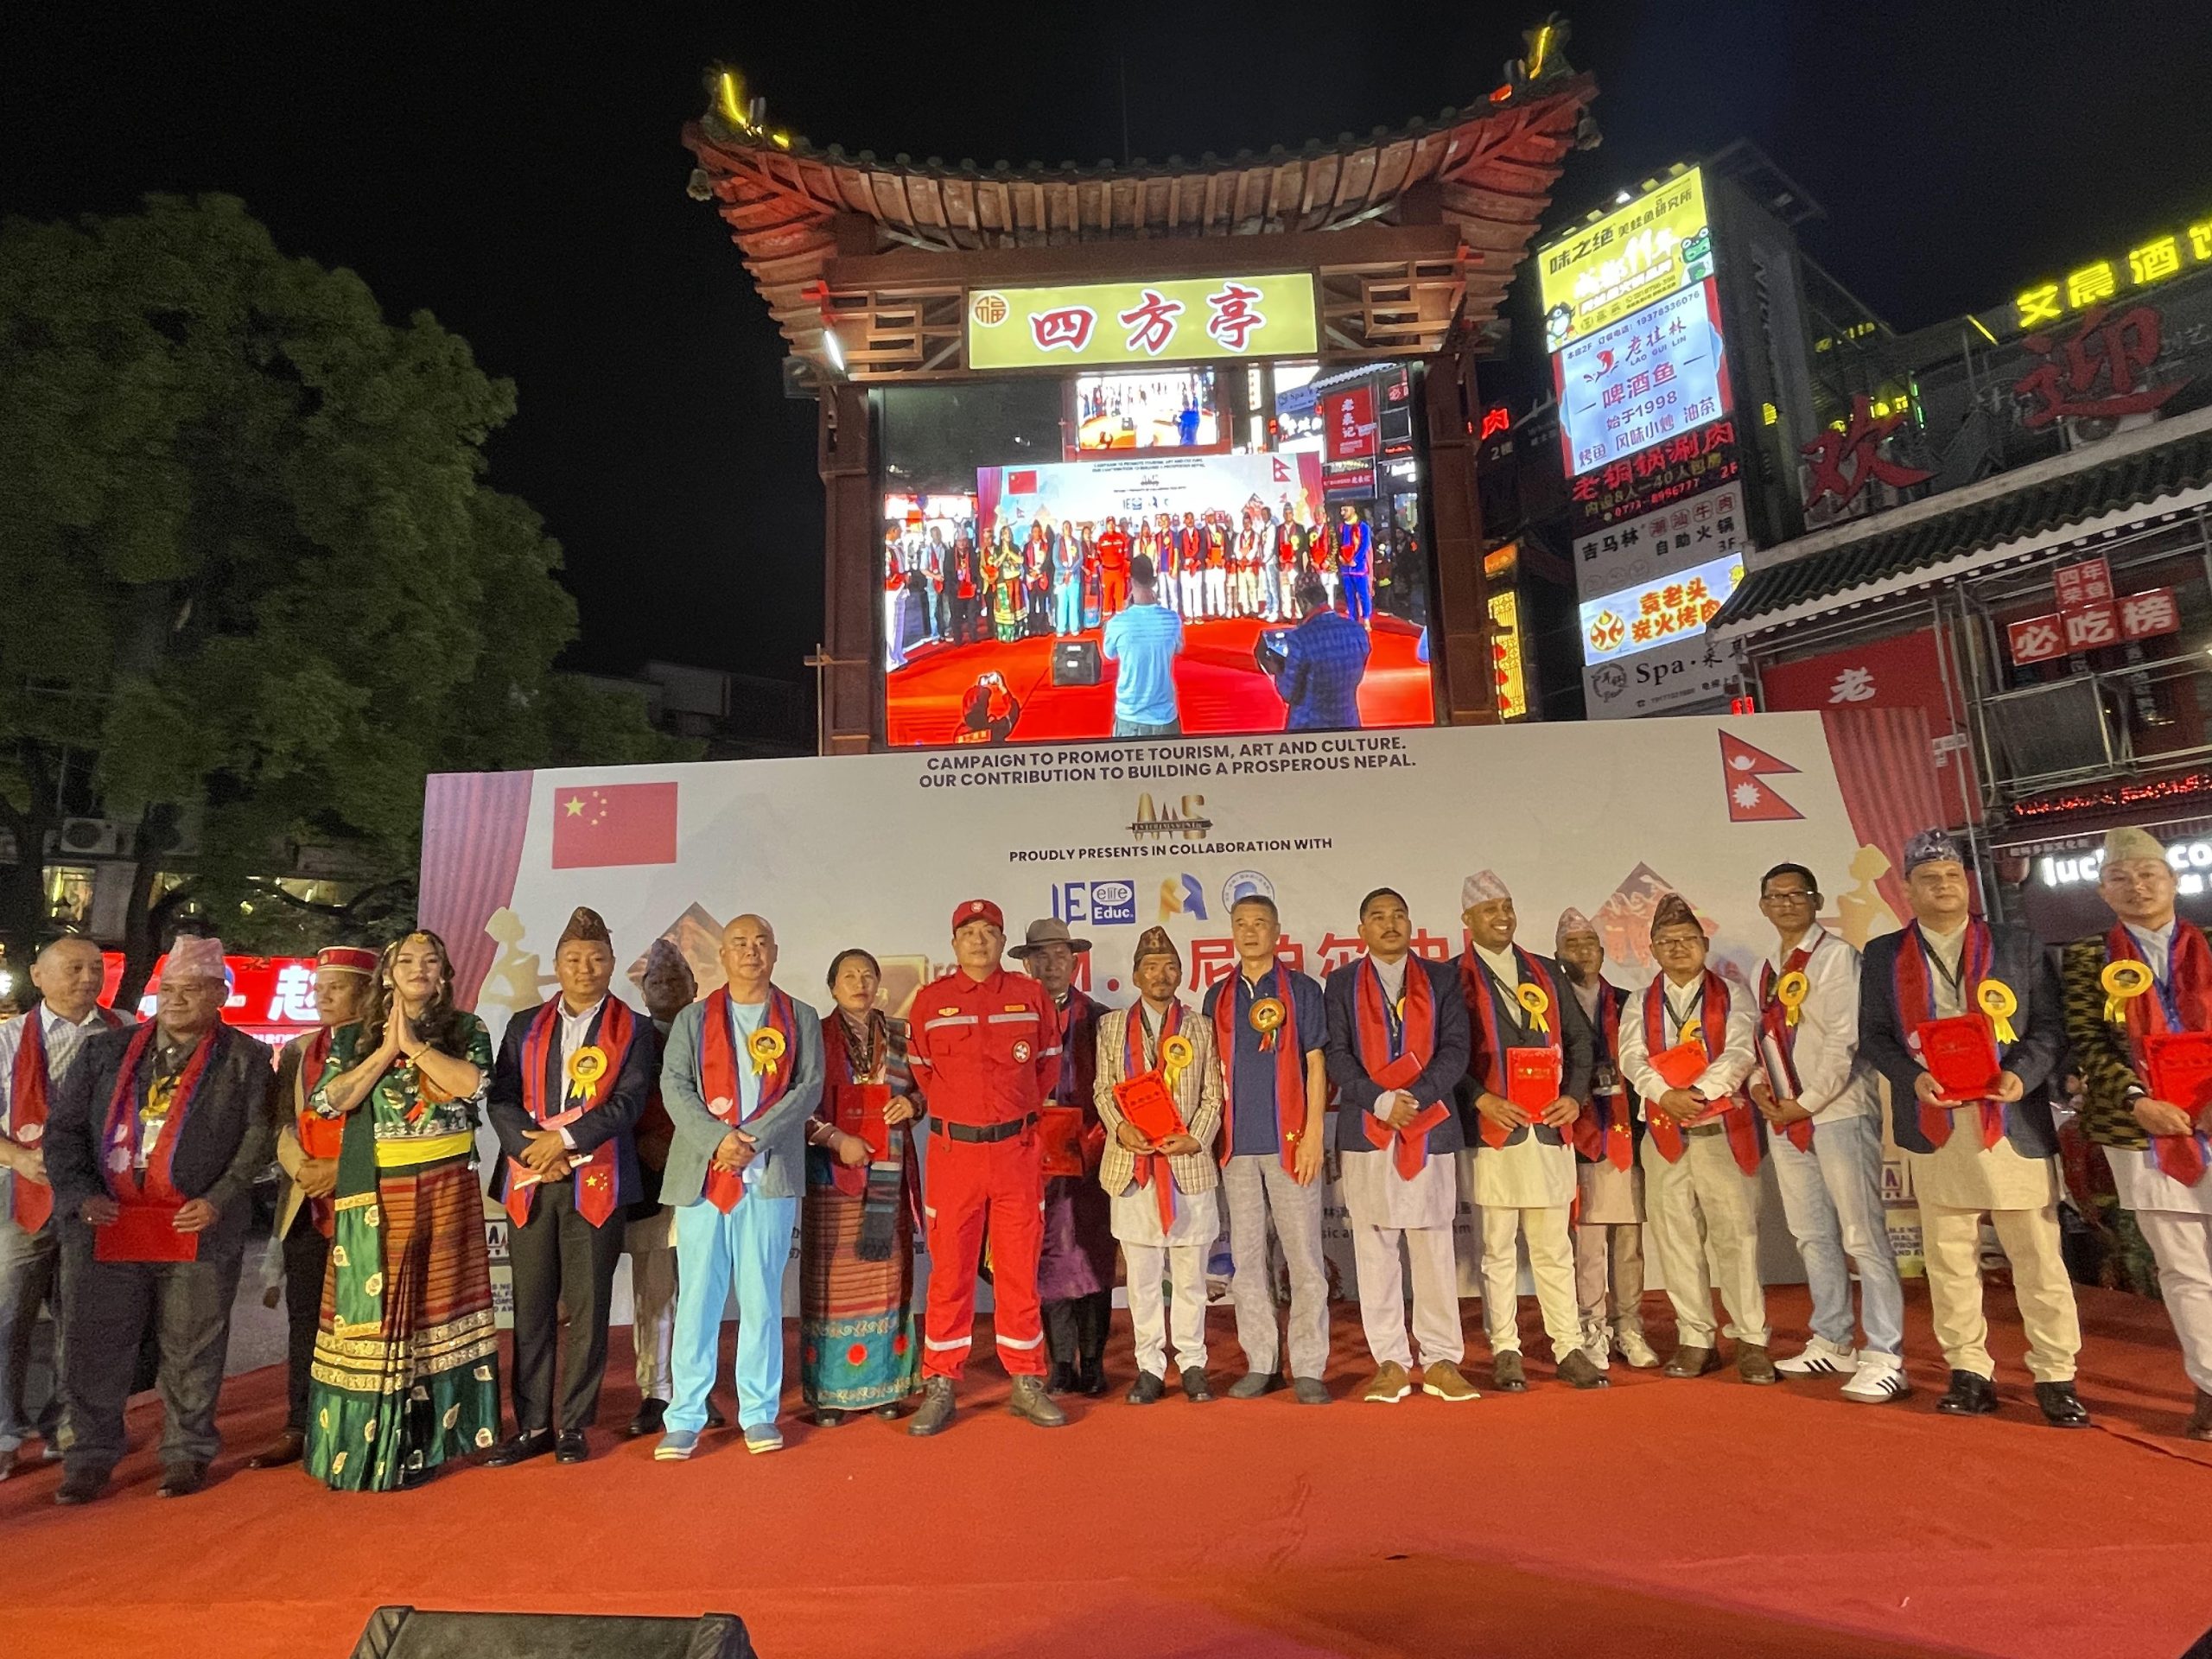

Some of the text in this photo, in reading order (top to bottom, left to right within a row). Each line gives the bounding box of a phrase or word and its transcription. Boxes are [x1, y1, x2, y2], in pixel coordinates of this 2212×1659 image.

[1032, 283, 1263, 353] 四方亭
[1625, 317, 1688, 361] 老桂林
[1630, 335, 1688, 365] LAO GUI LIN
[1602, 362, 1677, 410] 啤酒鱼
[1606, 391, 1678, 431] 始于1998
[1616, 414, 1675, 451] 风味小炒
[1684, 397, 1715, 423] 油茶
[1573, 422, 1735, 501] 老铜锅涮肉
[1582, 528, 1639, 562] 吉马林
[1656, 518, 1736, 556] 自助火锅
[1631, 599, 1721, 642] 炭火烤肉
[2017, 595, 2172, 658] 必吃榜
[1636, 659, 1685, 685] Spa
[1828, 667, 1878, 703] 老
[919, 753, 1416, 787] OUR CONTRIBUTION TO BUILDING A PROSPEROUS NEPAL.
[927, 736, 1407, 770] CAMPAIGN TO PROMOTE TOURISM, ART AND CULTURE.
[1009, 837, 1332, 862] PROUDLY PRESENTS IN COLLABORATION WITH
